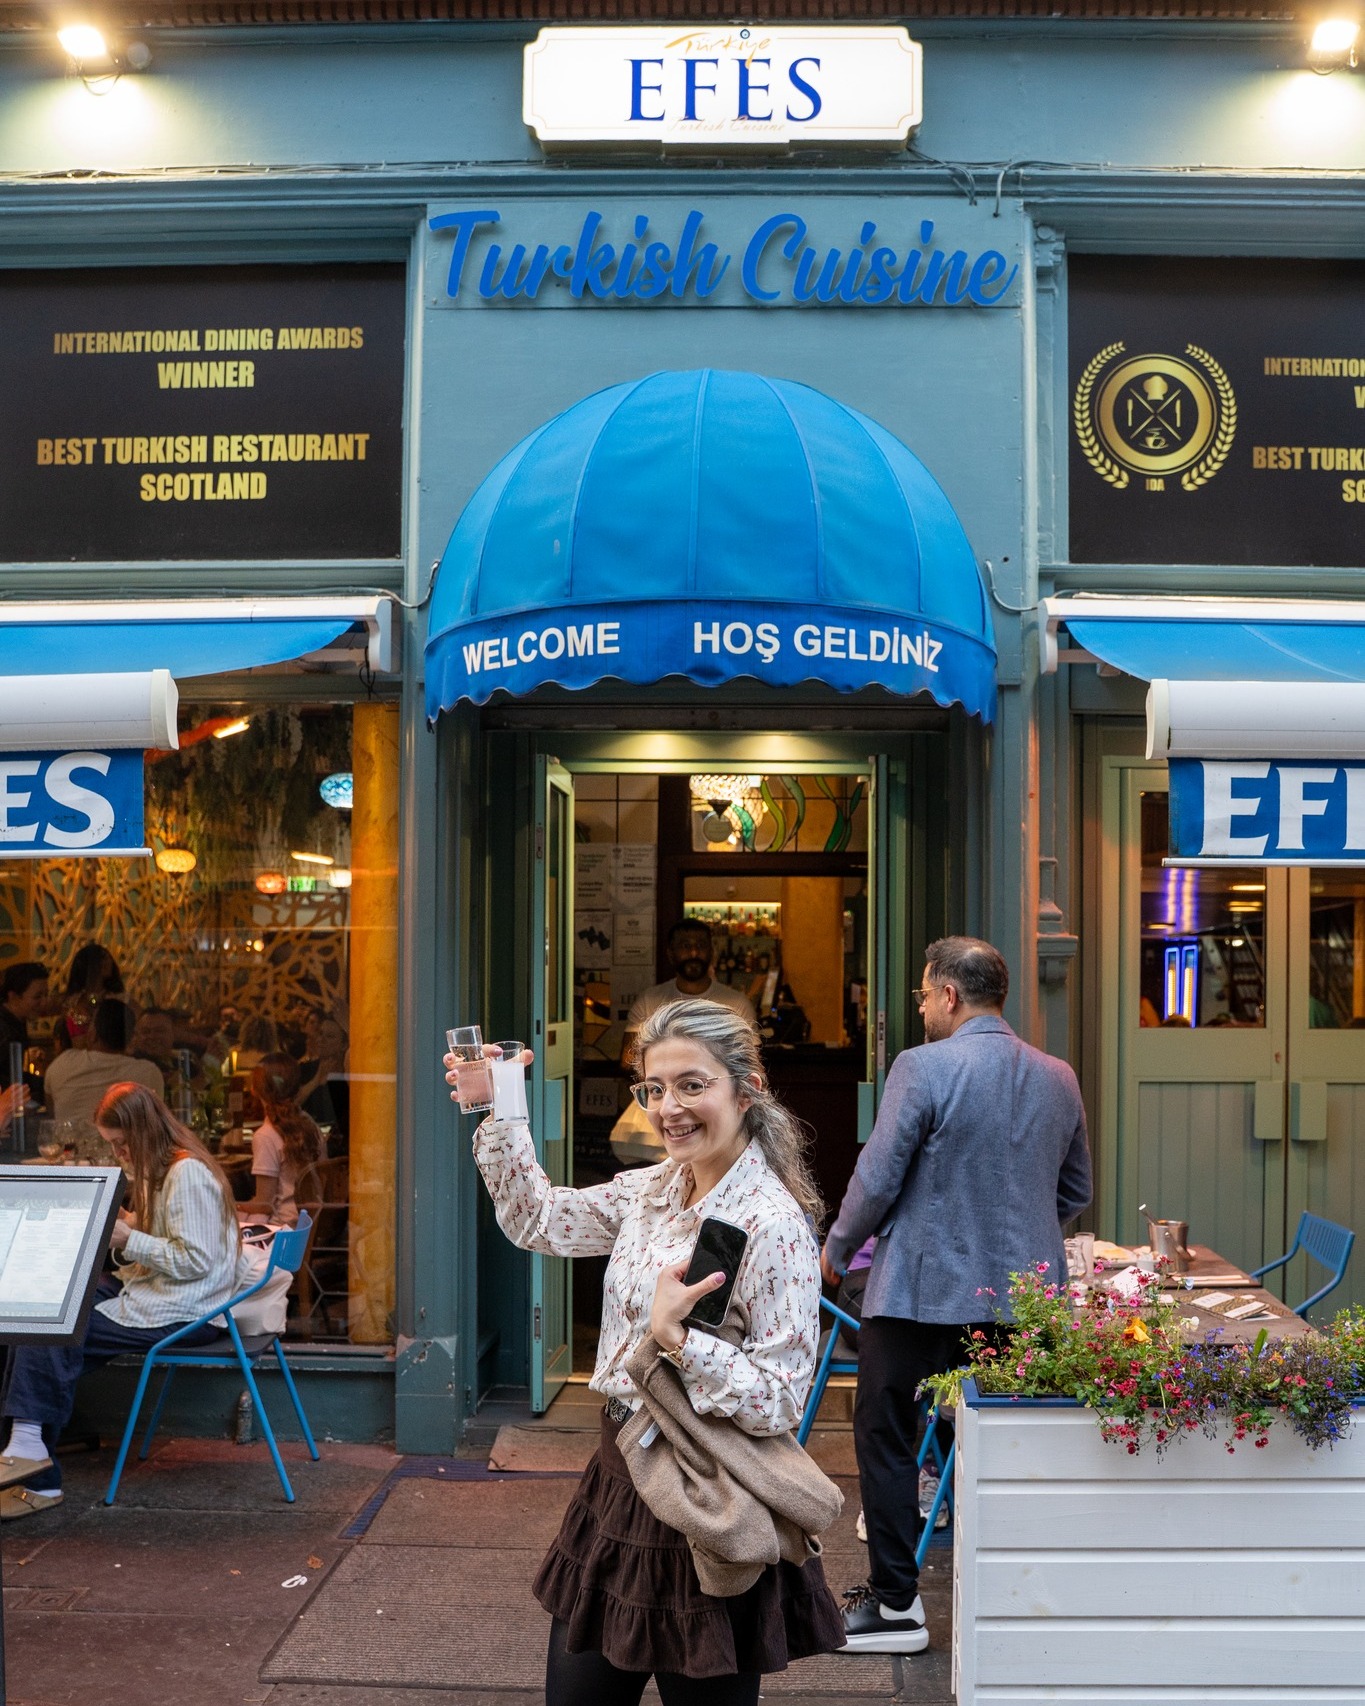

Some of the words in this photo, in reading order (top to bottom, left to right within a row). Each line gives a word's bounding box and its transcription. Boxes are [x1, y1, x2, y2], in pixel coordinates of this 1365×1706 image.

[625, 57, 823, 122] EFES
[429, 210, 731, 300] Turkish
[741, 213, 1019, 306] Cuisine
[54, 330, 201, 354] INTERNATIONAL
[204, 328, 274, 351] DINING
[277, 327, 364, 350] AWARDS
[157, 360, 255, 389] WINNER
[37, 438, 97, 465] BEST
[101, 435, 208, 464] TURKISH
[212, 433, 370, 463] RESTAURANT
[1252, 446, 1305, 470] BEST
[1307, 447, 1365, 472] TURK
[140, 472, 267, 501] SCOTLAND
[1145, 478, 1165, 492] IDA
[462, 621, 620, 676] WELCOME
[693, 621, 781, 664] HOŞ
[792, 623, 944, 673] GELDİNİZ
